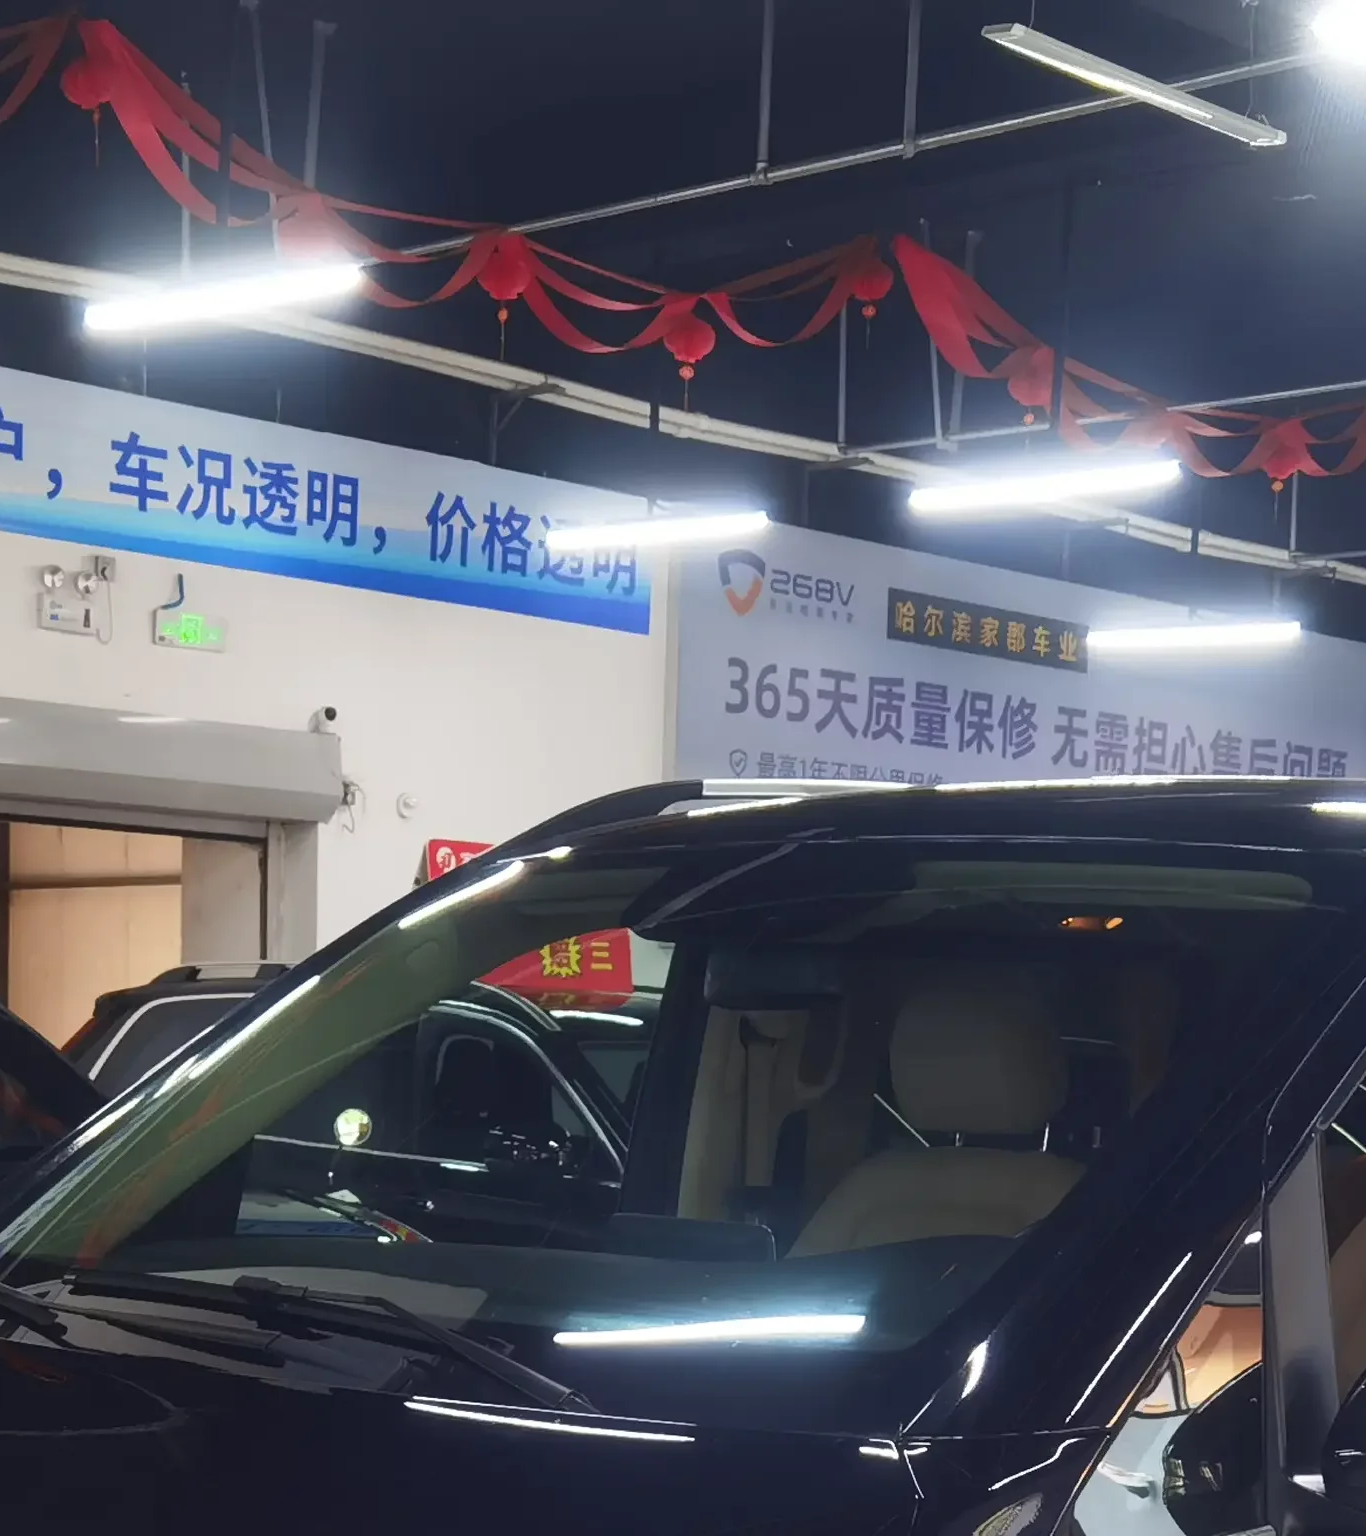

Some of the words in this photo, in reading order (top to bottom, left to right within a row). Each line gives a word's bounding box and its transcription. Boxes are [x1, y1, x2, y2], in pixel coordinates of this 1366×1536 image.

[770, 568, 854, 607] 268V
[895, 601, 1078, 662] 哈尔滨家郡车业
[724, 657, 1038, 760] 365天质量保修
